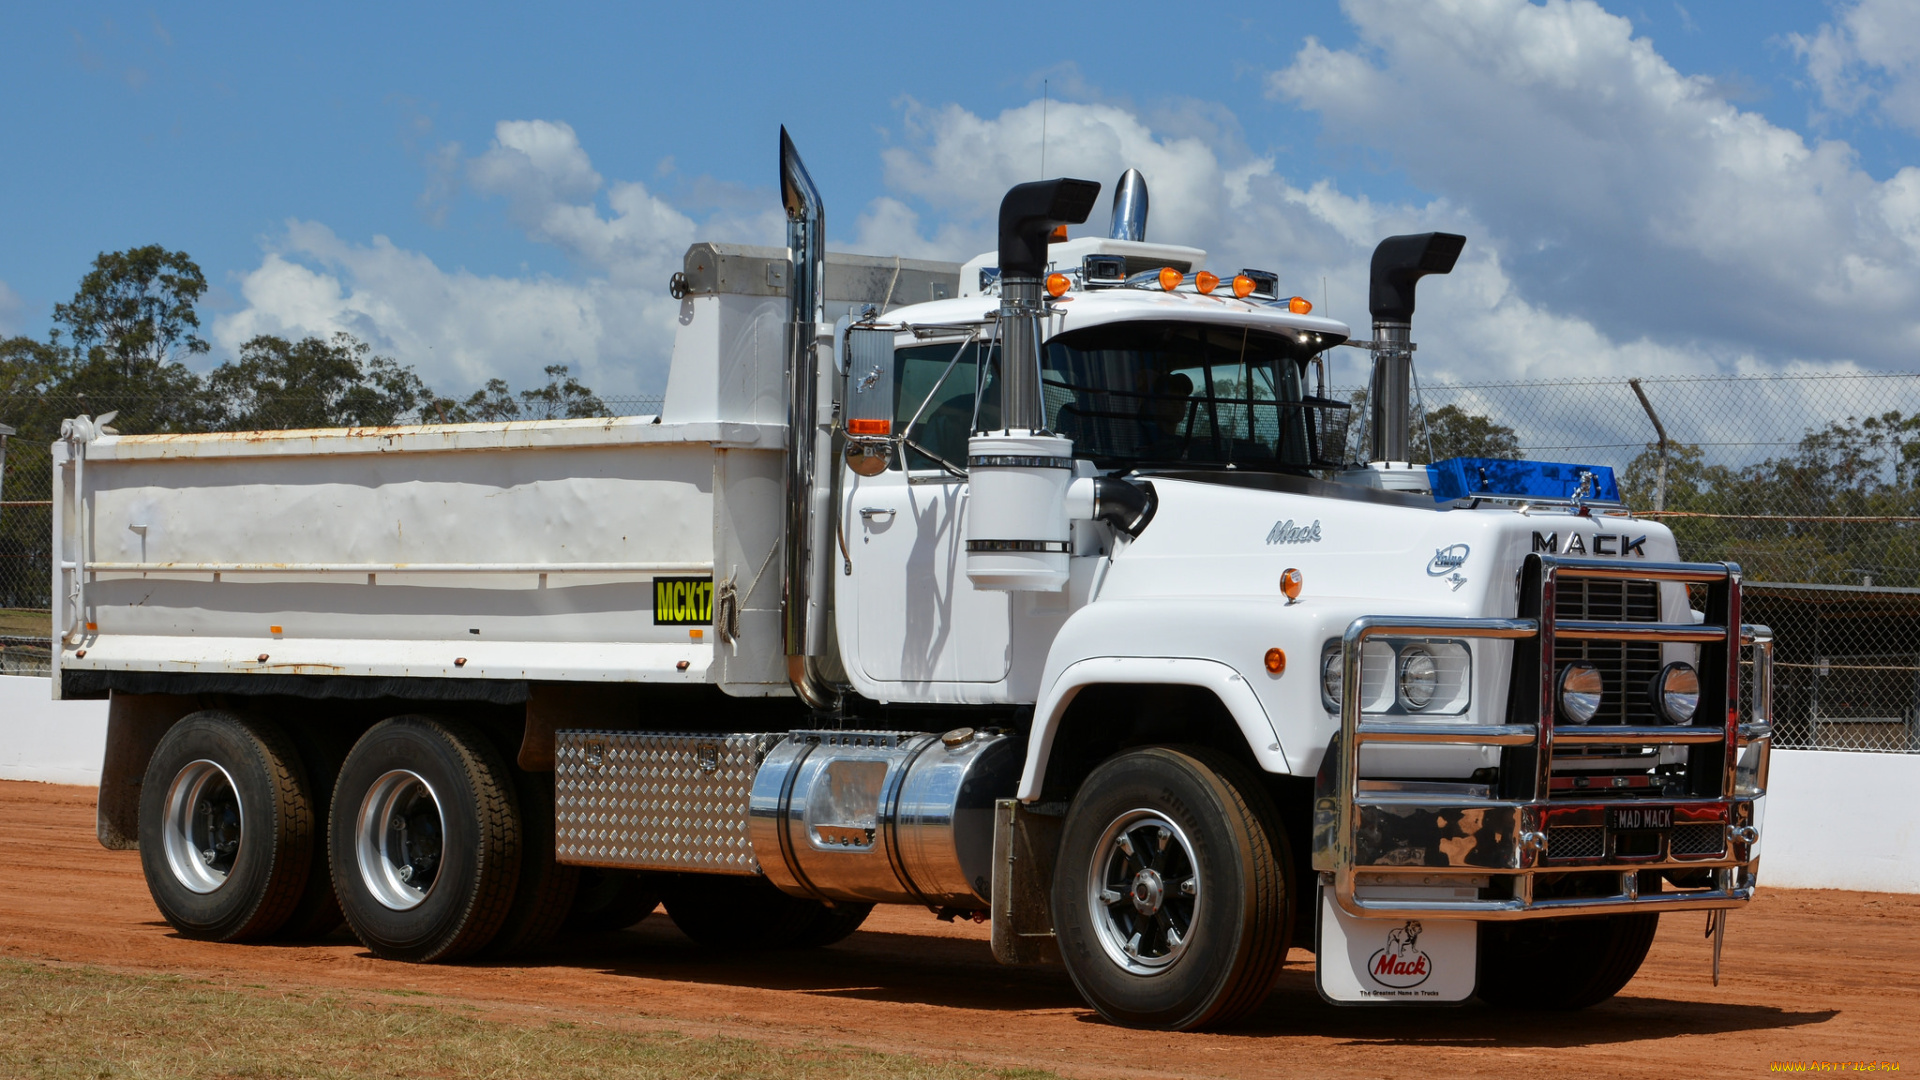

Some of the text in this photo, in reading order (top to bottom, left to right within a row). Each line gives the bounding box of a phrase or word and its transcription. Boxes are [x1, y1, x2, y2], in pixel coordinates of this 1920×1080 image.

[1265, 519, 1322, 545] Mack
[1532, 530, 1647, 557] MACK
[657, 581, 714, 621] MCK17
[1619, 809, 1671, 828] MAD MACK
[1374, 954, 1427, 975] Mack
